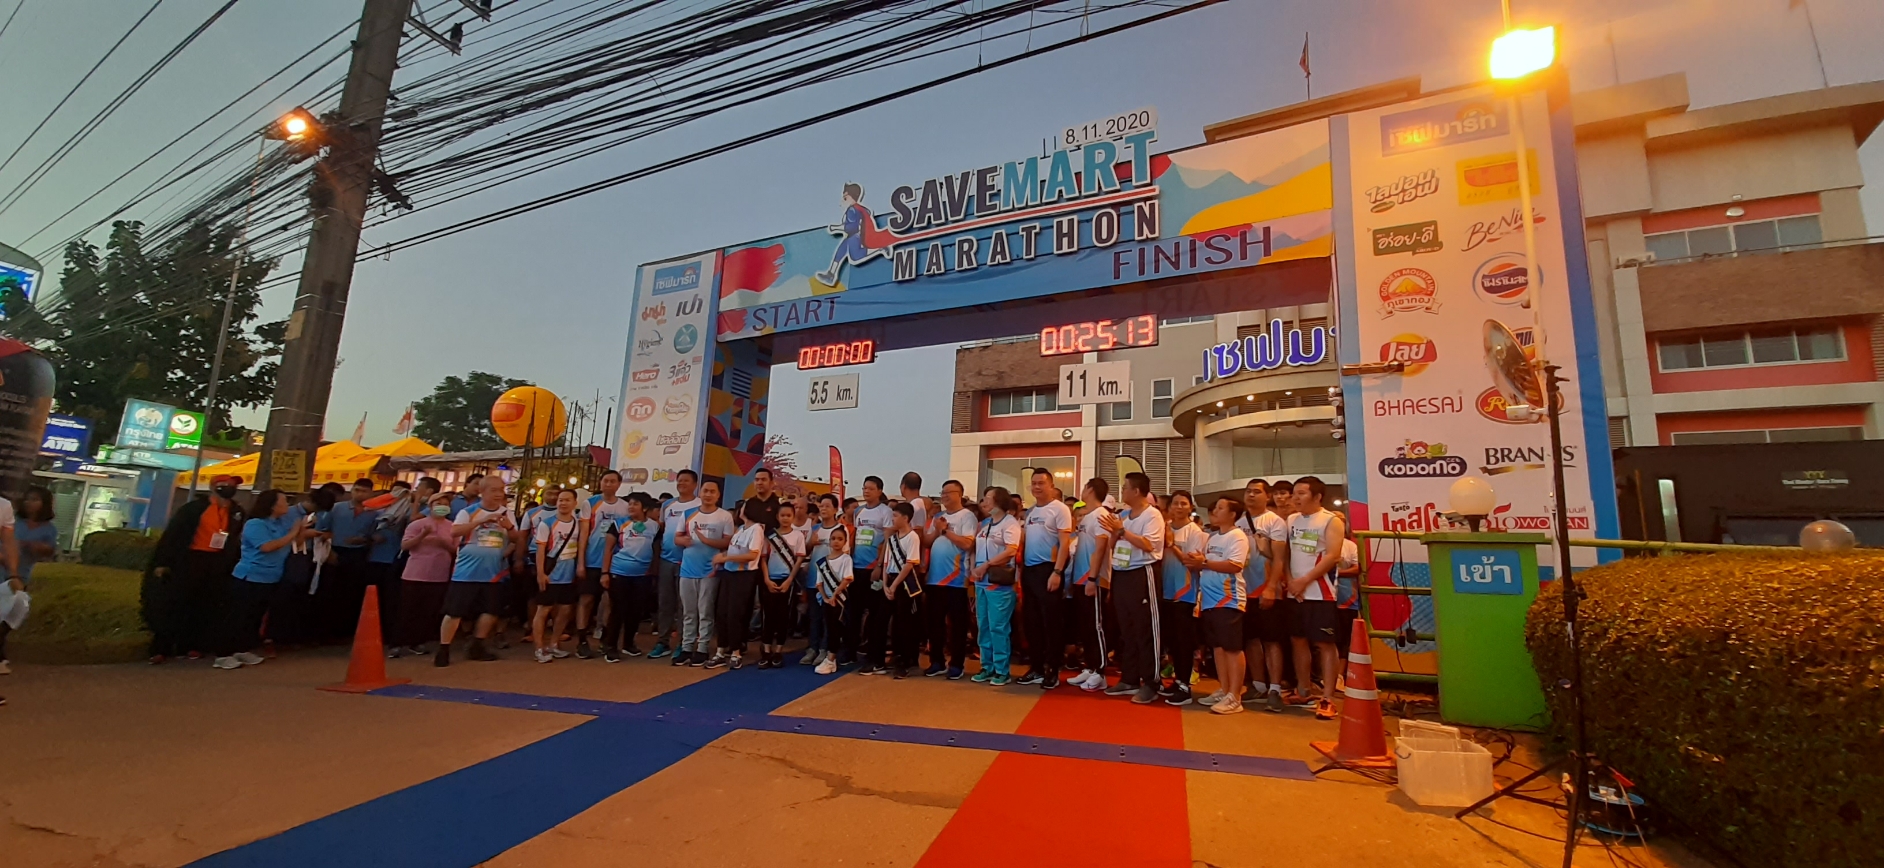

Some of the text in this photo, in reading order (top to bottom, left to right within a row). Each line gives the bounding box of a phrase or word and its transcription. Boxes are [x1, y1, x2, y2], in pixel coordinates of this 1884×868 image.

[892, 199, 1160, 282] MARATHON
[1113, 226, 1272, 280] FINISH
[1380, 271, 1401, 297] GOLDEN
[676, 293, 704, 317] เปา
[752, 296, 841, 332] START
[1041, 315, 1154, 355] 00:25:13
[799, 341, 873, 369] 00:00:00
[1202, 318, 1335, 382] เซฟม
[635, 371, 657, 381] Hero
[1066, 369, 1122, 398] 11 km.
[810, 381, 854, 405] 5.5 km.
[1374, 396, 1463, 417] BHAESAJ
[42, 439, 80, 452] ATM
[1384, 460, 1460, 475] KODOMO
[1459, 555, 1512, 584] เข้า
